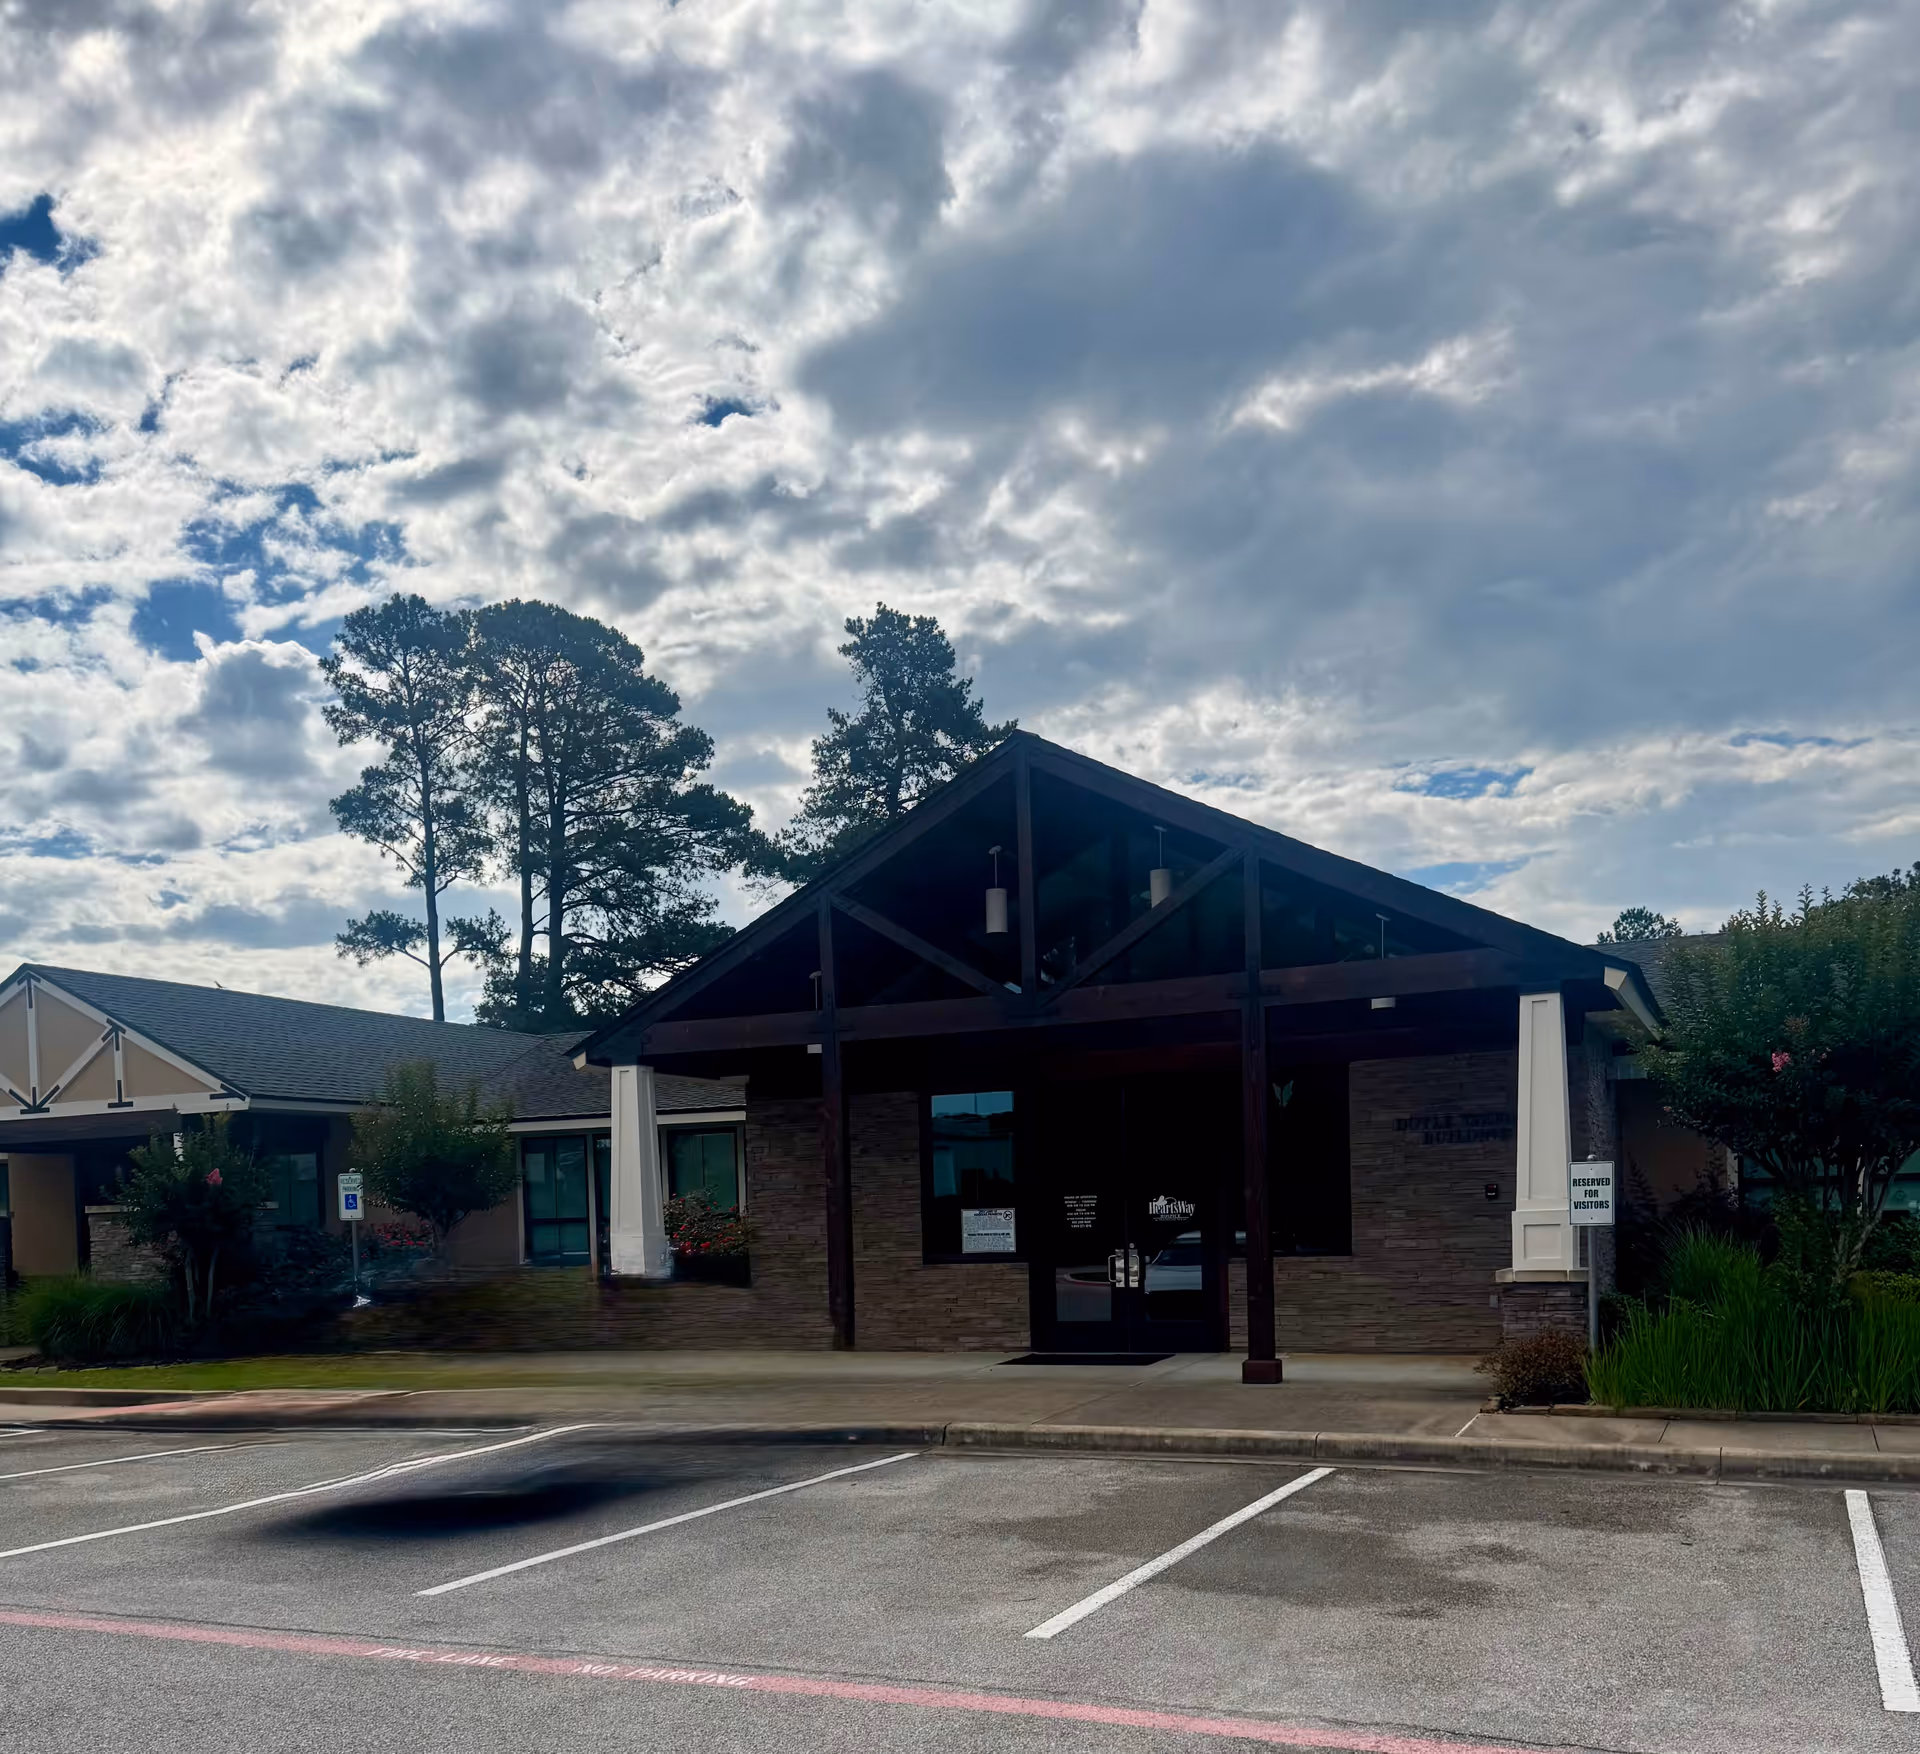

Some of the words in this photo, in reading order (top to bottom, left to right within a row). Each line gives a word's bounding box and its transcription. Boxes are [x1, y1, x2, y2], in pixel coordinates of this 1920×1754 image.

[1572, 1178, 1611, 1187] RESERVED
[1584, 1189, 1599, 1198] FOR
[1573, 1200, 1610, 1209] VISITORS
[365, 1648, 434, 1660] FIRE
[435, 1653, 517, 1666] LANE
[572, 1664, 619, 1675] NO
[625, 1668, 756, 1686] PARKING
